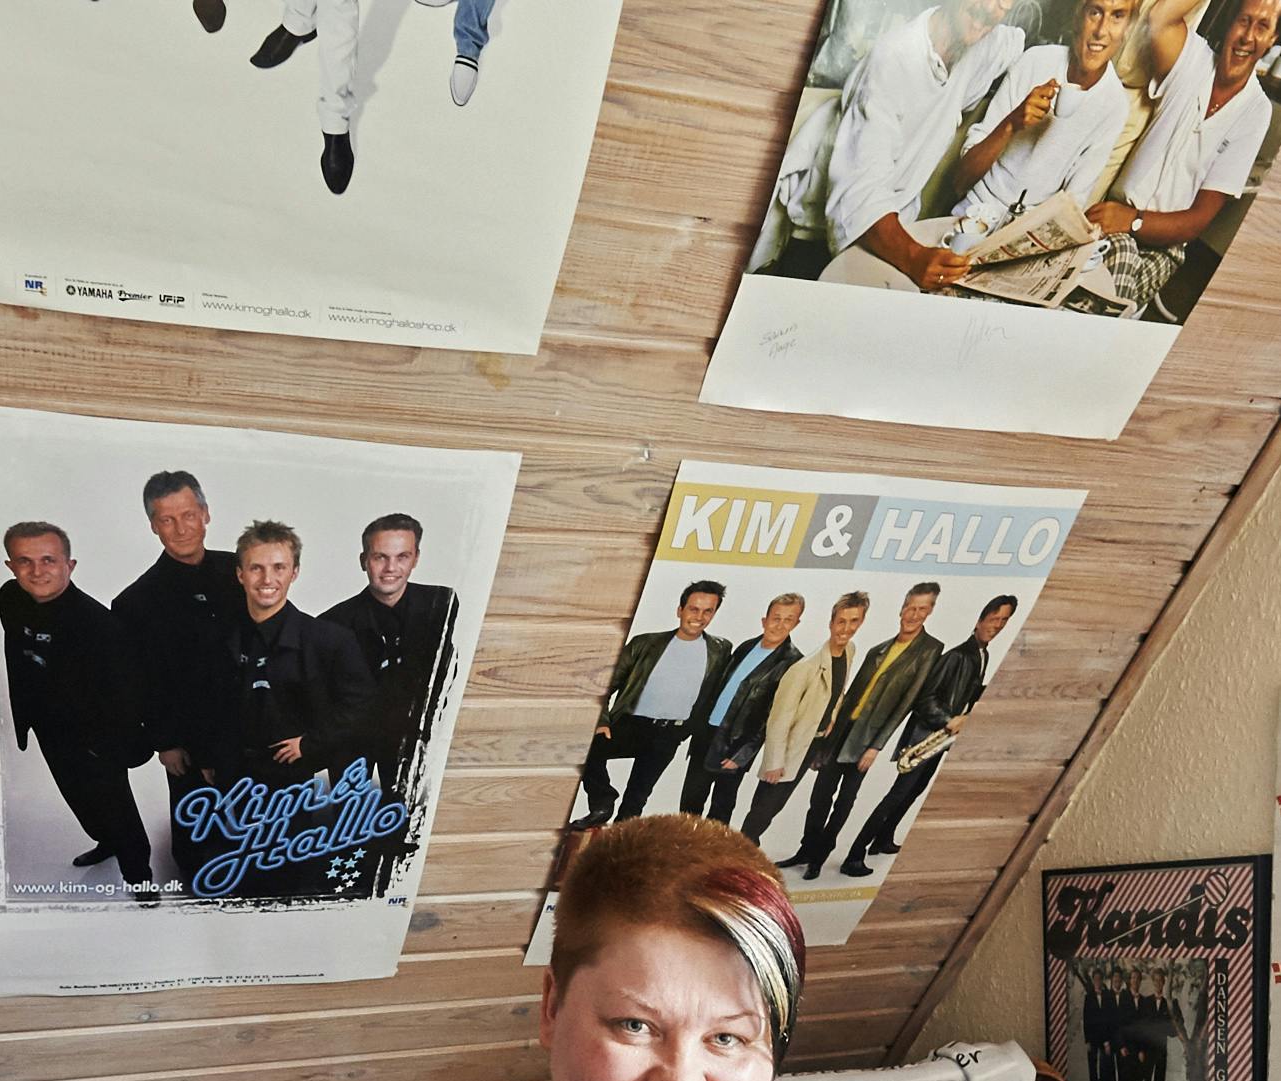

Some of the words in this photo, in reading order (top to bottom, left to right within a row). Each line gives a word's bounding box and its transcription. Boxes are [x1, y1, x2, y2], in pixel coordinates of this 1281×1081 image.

[77, 286, 113, 299] YAMAHA
[118, 289, 153, 301] Premier
[202, 300, 312, 319] www.kimoghallo.dk
[670, 494, 800, 555] KIM
[811, 504, 854, 559] &
[870, 507, 1062, 568] HALLO
[174, 777, 329, 843] Kim
[192, 790, 408, 898] Hallo
[13, 880, 184, 896] www.kim-og-hallo.dk
[1046, 880, 1252, 960] Kandis
[1216, 972, 1227, 1055] DANSEN
